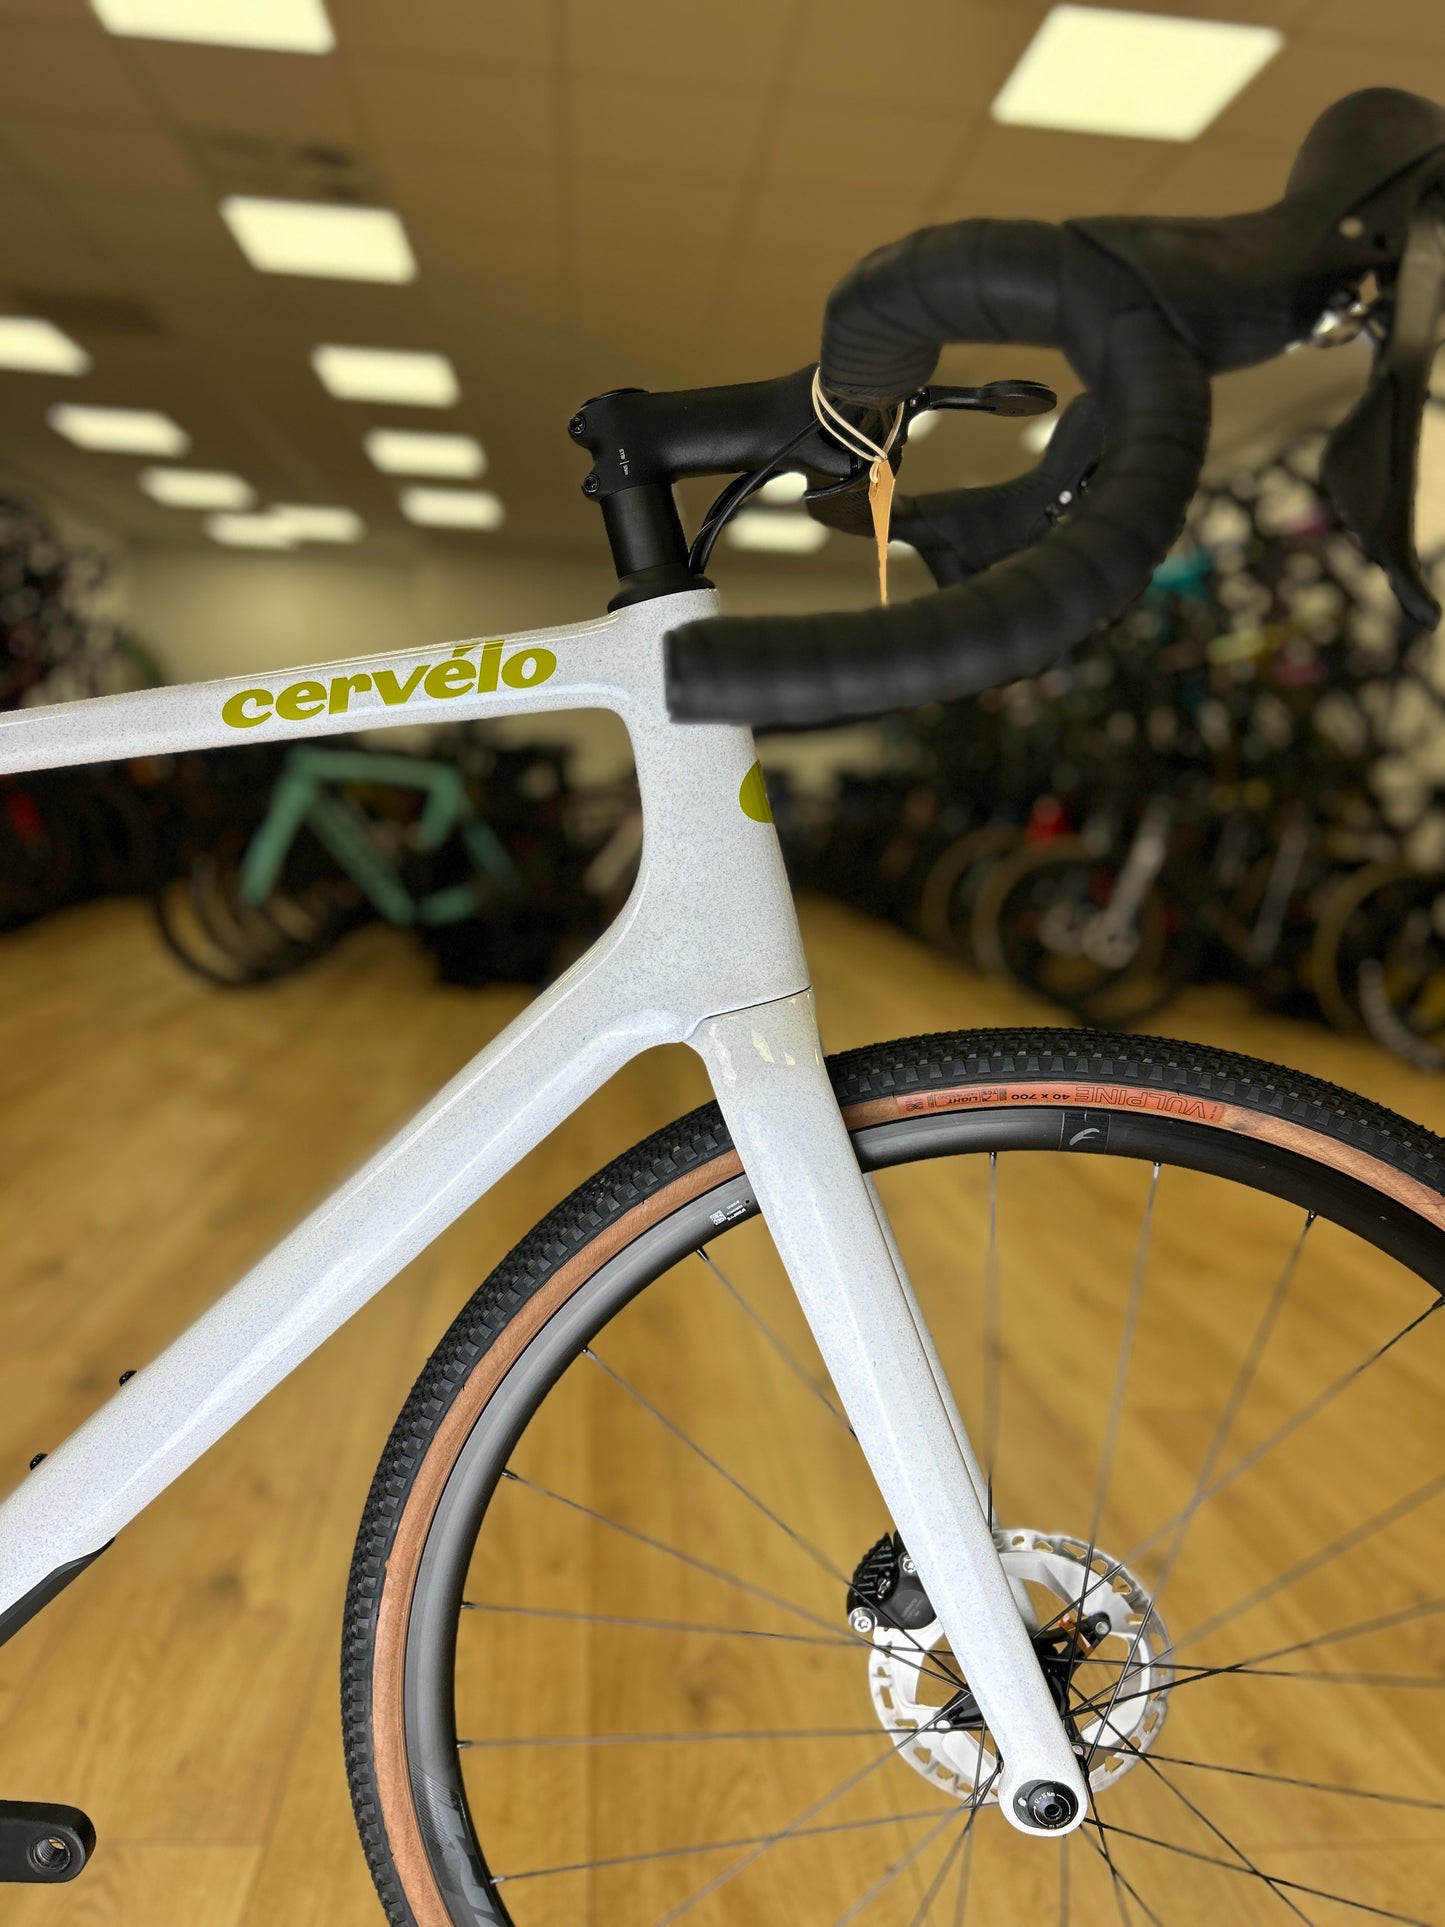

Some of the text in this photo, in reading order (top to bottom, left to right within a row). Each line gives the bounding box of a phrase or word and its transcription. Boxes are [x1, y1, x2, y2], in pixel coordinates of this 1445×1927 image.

[222, 640, 557, 728] cervélo
[948, 1096, 978, 1104] LIGHT
[1074, 1086, 1206, 1119] VULPINE
